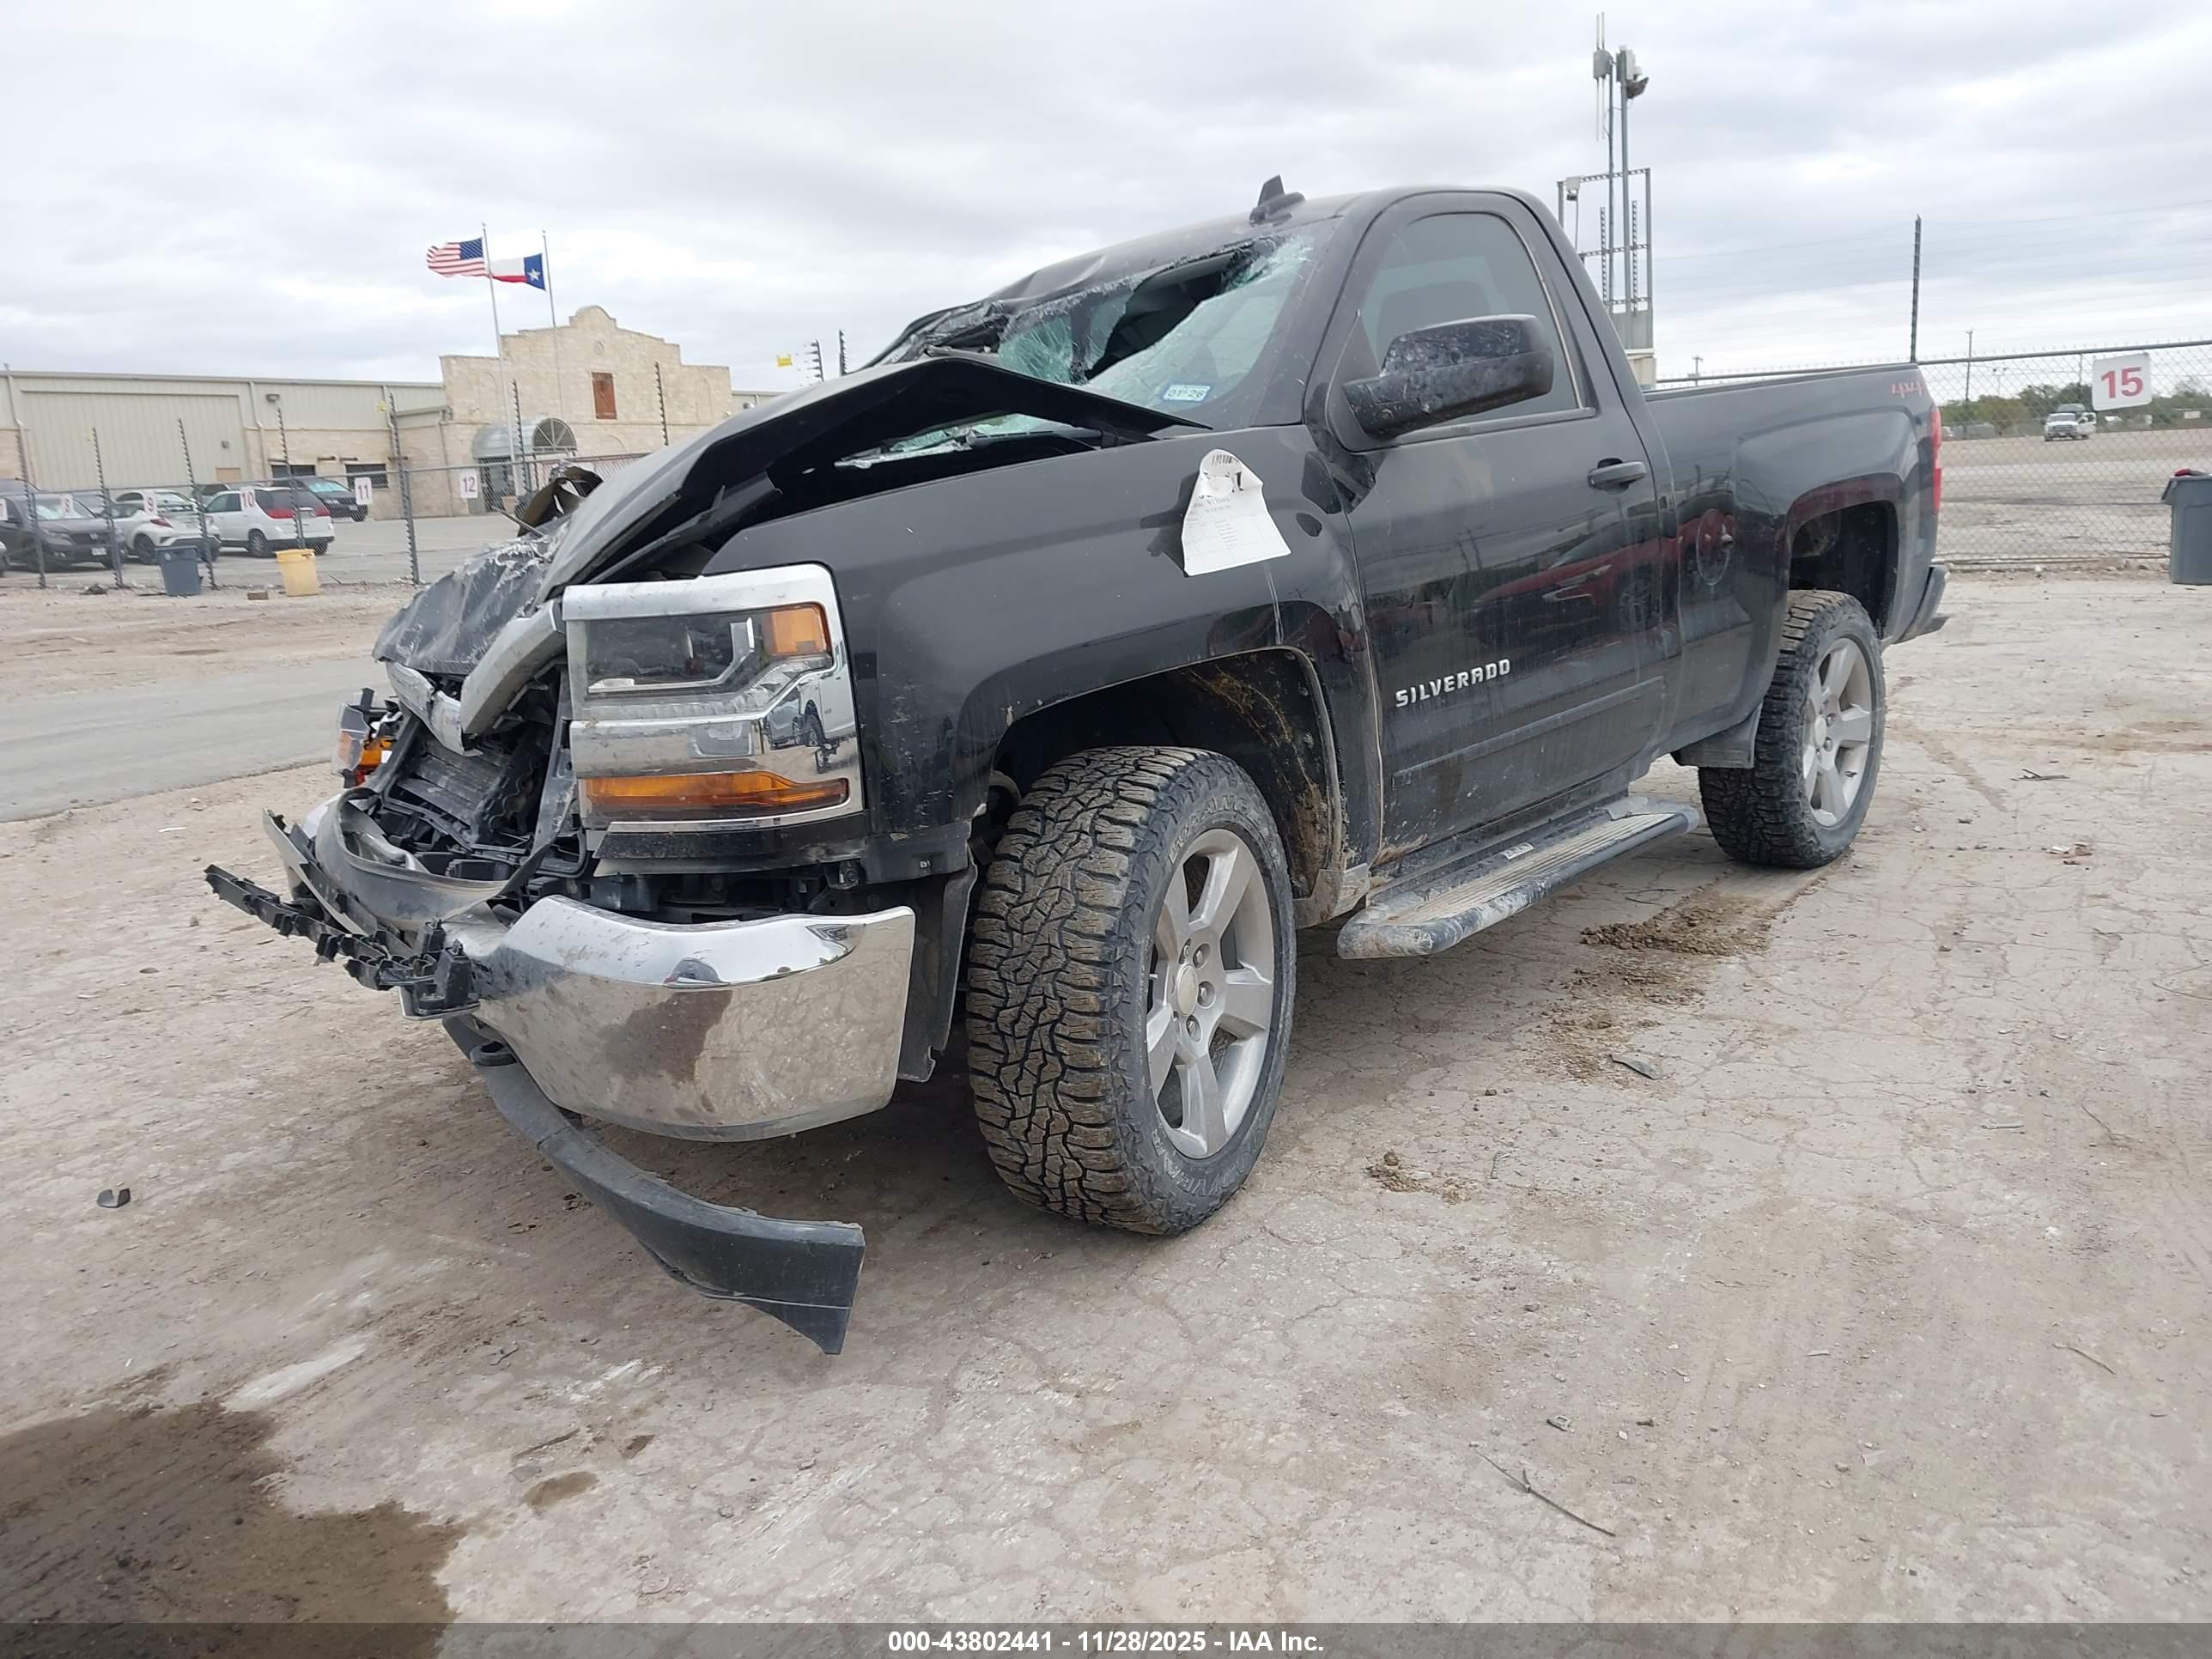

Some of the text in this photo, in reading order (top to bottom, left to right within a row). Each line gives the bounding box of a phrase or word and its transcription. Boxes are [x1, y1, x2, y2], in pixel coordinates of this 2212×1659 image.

[2101, 367, 2144, 399] 15
[357, 484, 369, 500] 11
[464, 477, 476, 493] 12
[241, 491, 255, 507] 10
[1395, 658, 1511, 708] SILVERADO
